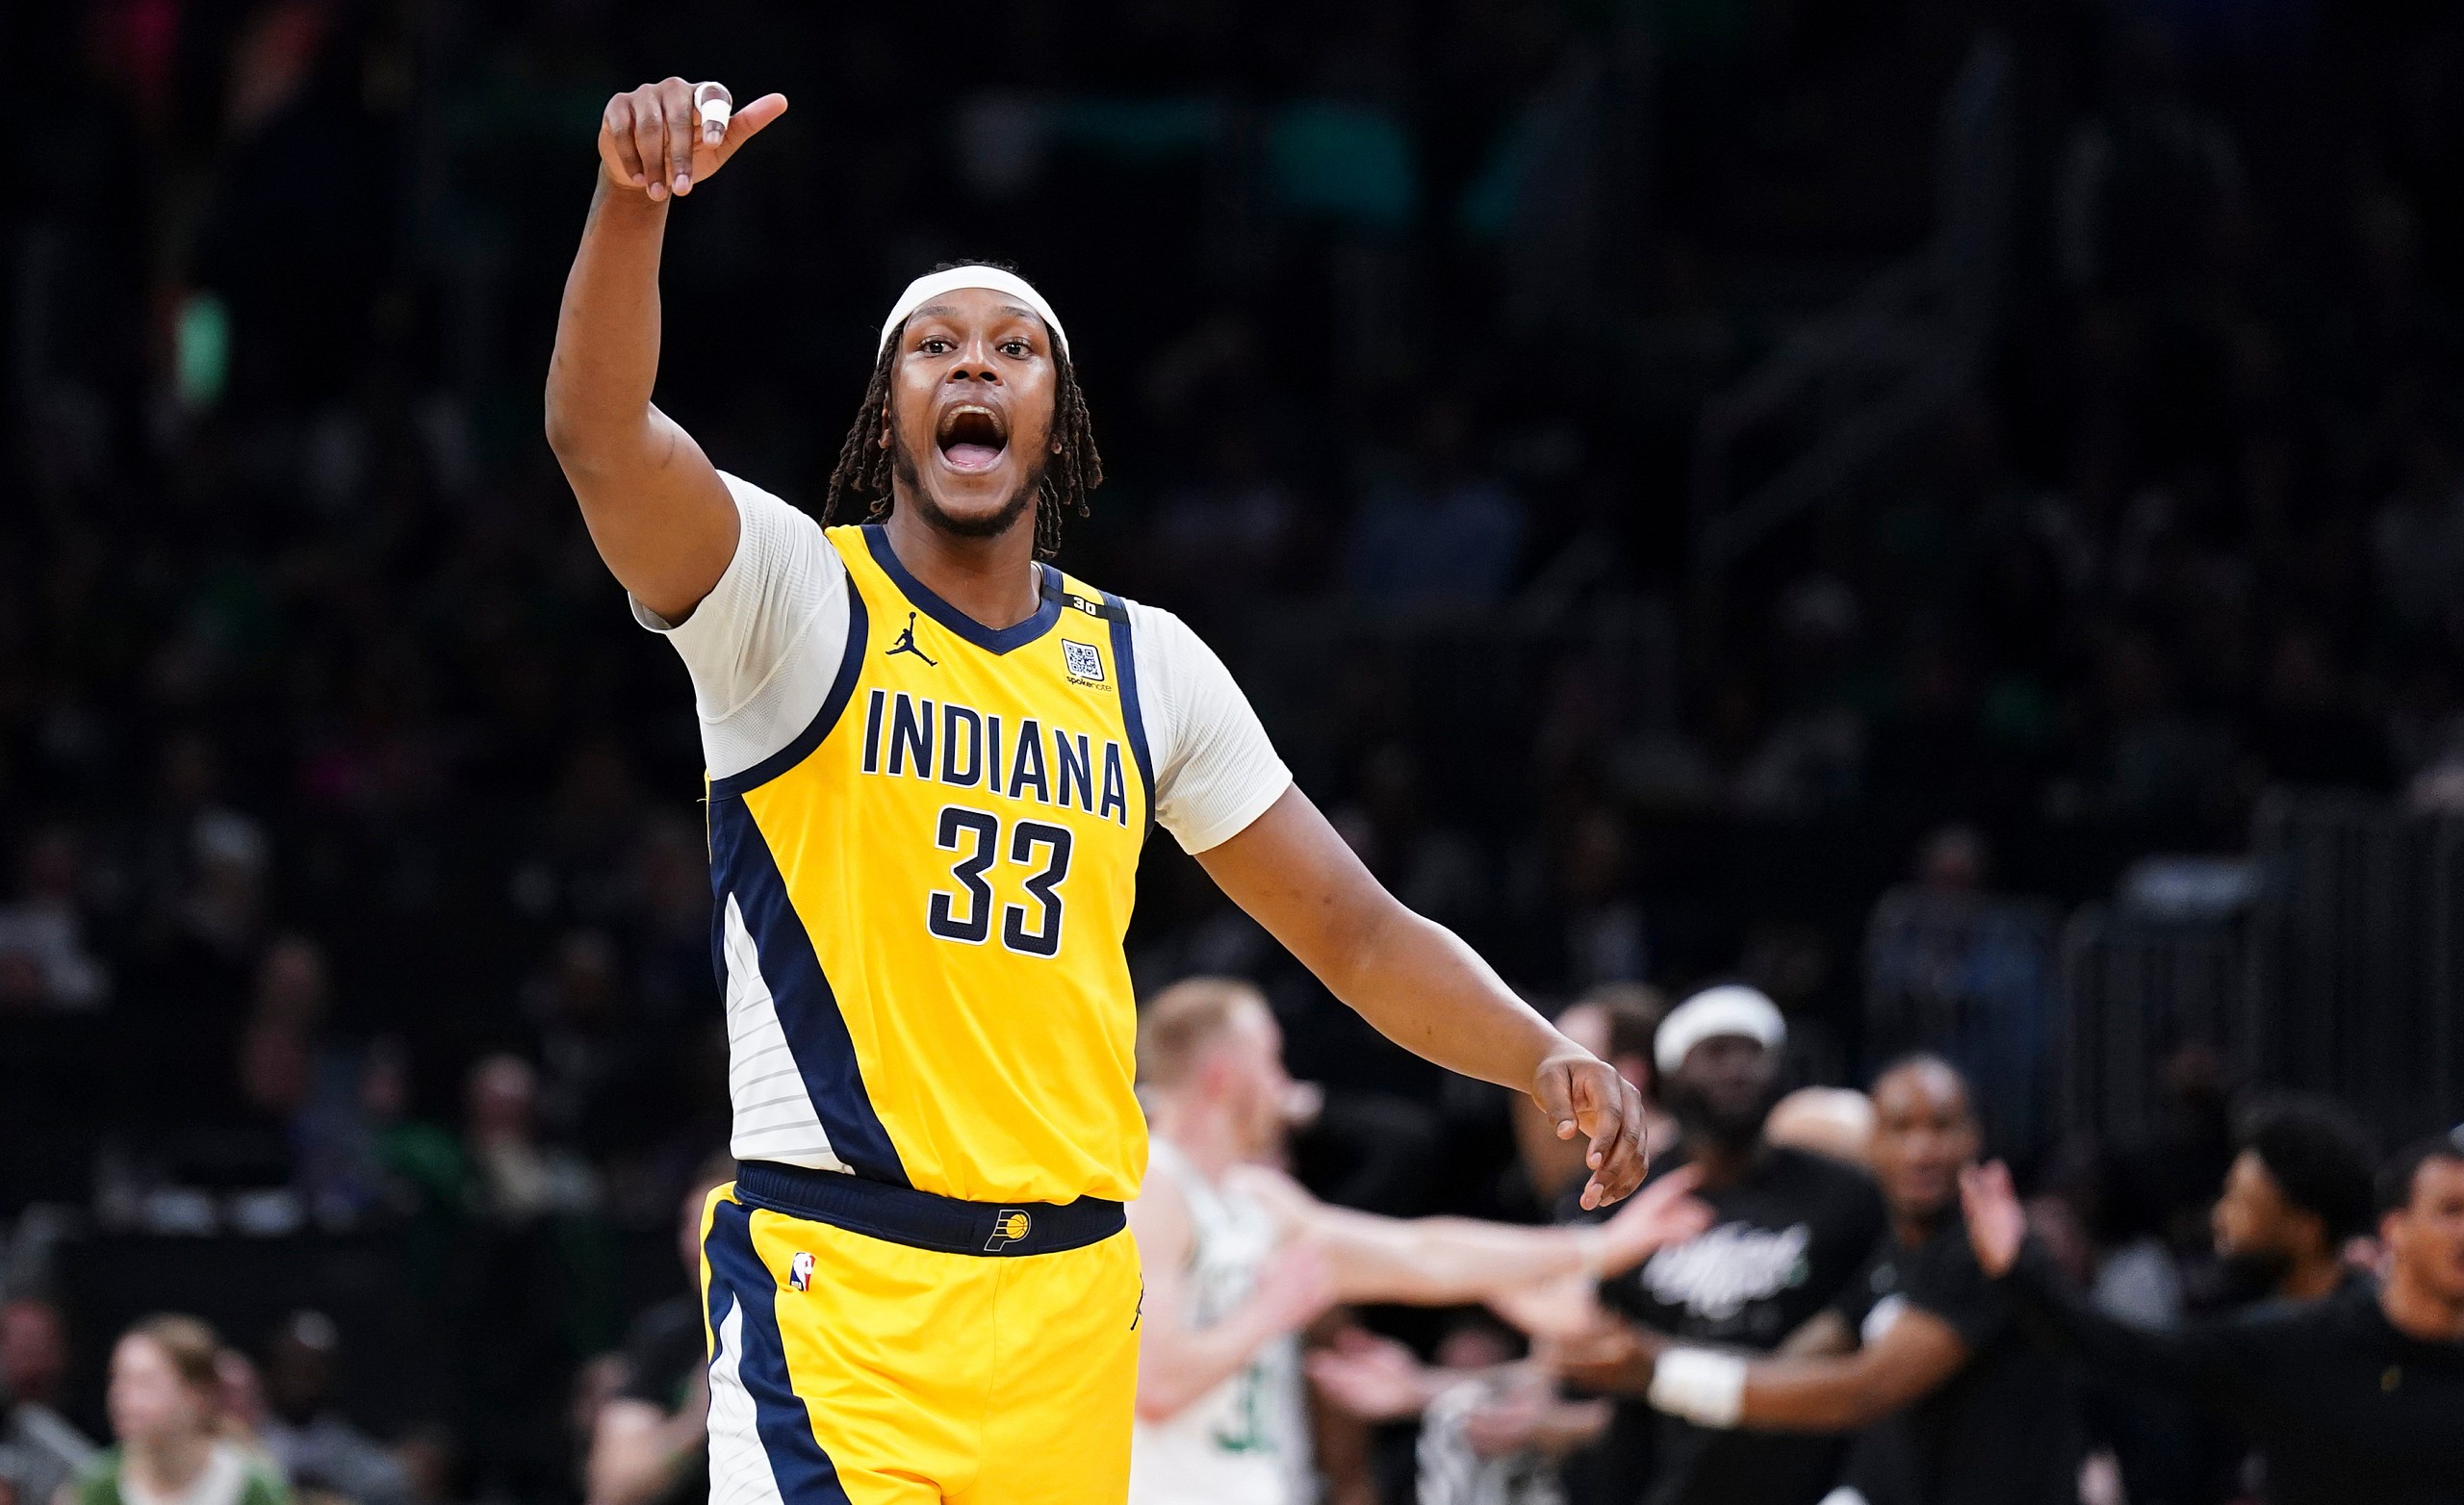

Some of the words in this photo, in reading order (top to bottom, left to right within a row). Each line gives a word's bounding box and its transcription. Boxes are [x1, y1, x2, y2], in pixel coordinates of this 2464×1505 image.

[1073, 597, 1096, 616] 30
[1066, 676, 1112, 692] spokenote
[861, 687, 1128, 829] INDIANA
[926, 804, 1072, 958] 33
